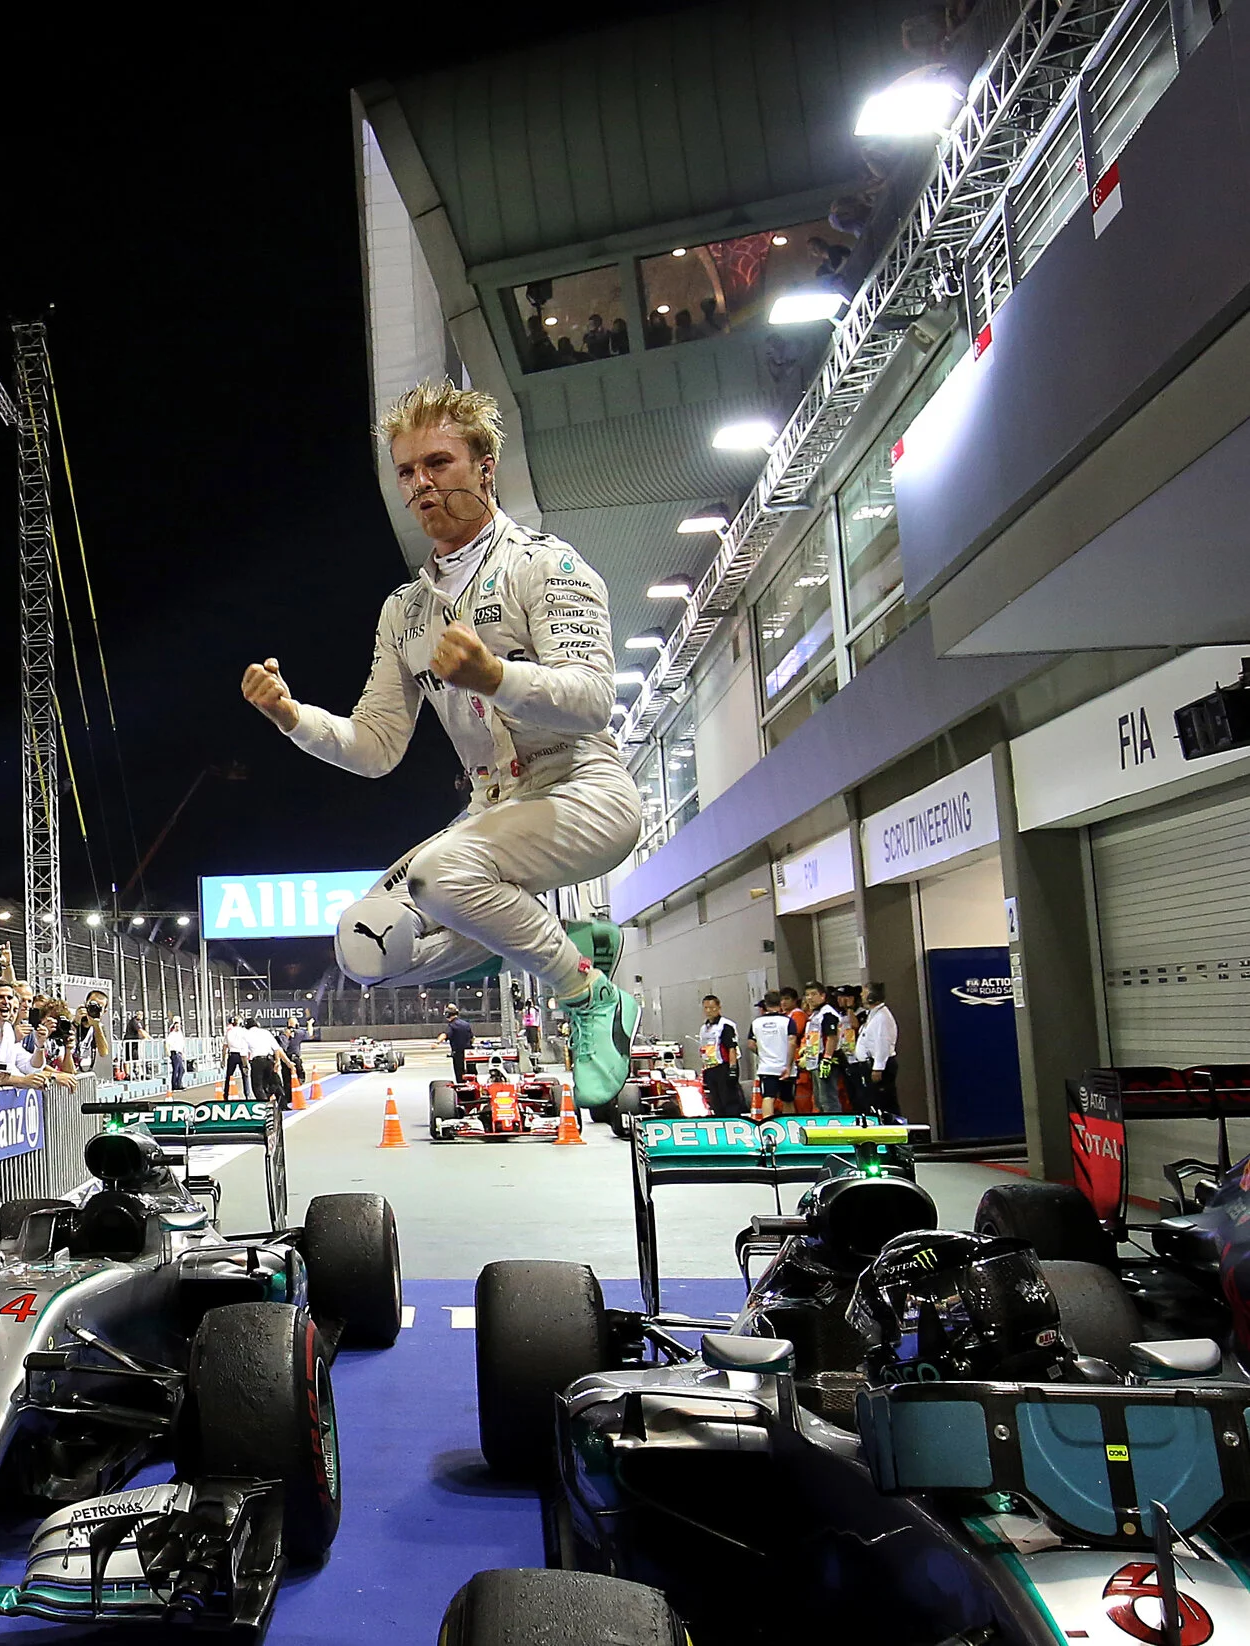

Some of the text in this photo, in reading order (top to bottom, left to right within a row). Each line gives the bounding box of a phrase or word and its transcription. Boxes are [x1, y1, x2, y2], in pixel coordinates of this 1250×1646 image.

[547, 608, 585, 618] Allianz
[550, 622, 600, 636] EPSON
[1118, 706, 1156, 770] FIA
[883, 791, 972, 863] SCRUTINEERING
[215, 880, 369, 928] Allia
[1009, 907, 1015, 932] 2
[980, 986, 1002, 995] ROAD
[981, 977, 1012, 987] ACTIO
[254, 1007, 304, 1019] AIRLINES
[1090, 1093, 1107, 1111] AT&T
[1075, 1123, 1121, 1161] TOTAL
[1038, 1331, 1057, 1343] BELL
[72, 1502, 144, 1522] PETRONAS
[1102, 1561, 1214, 1646] 6
